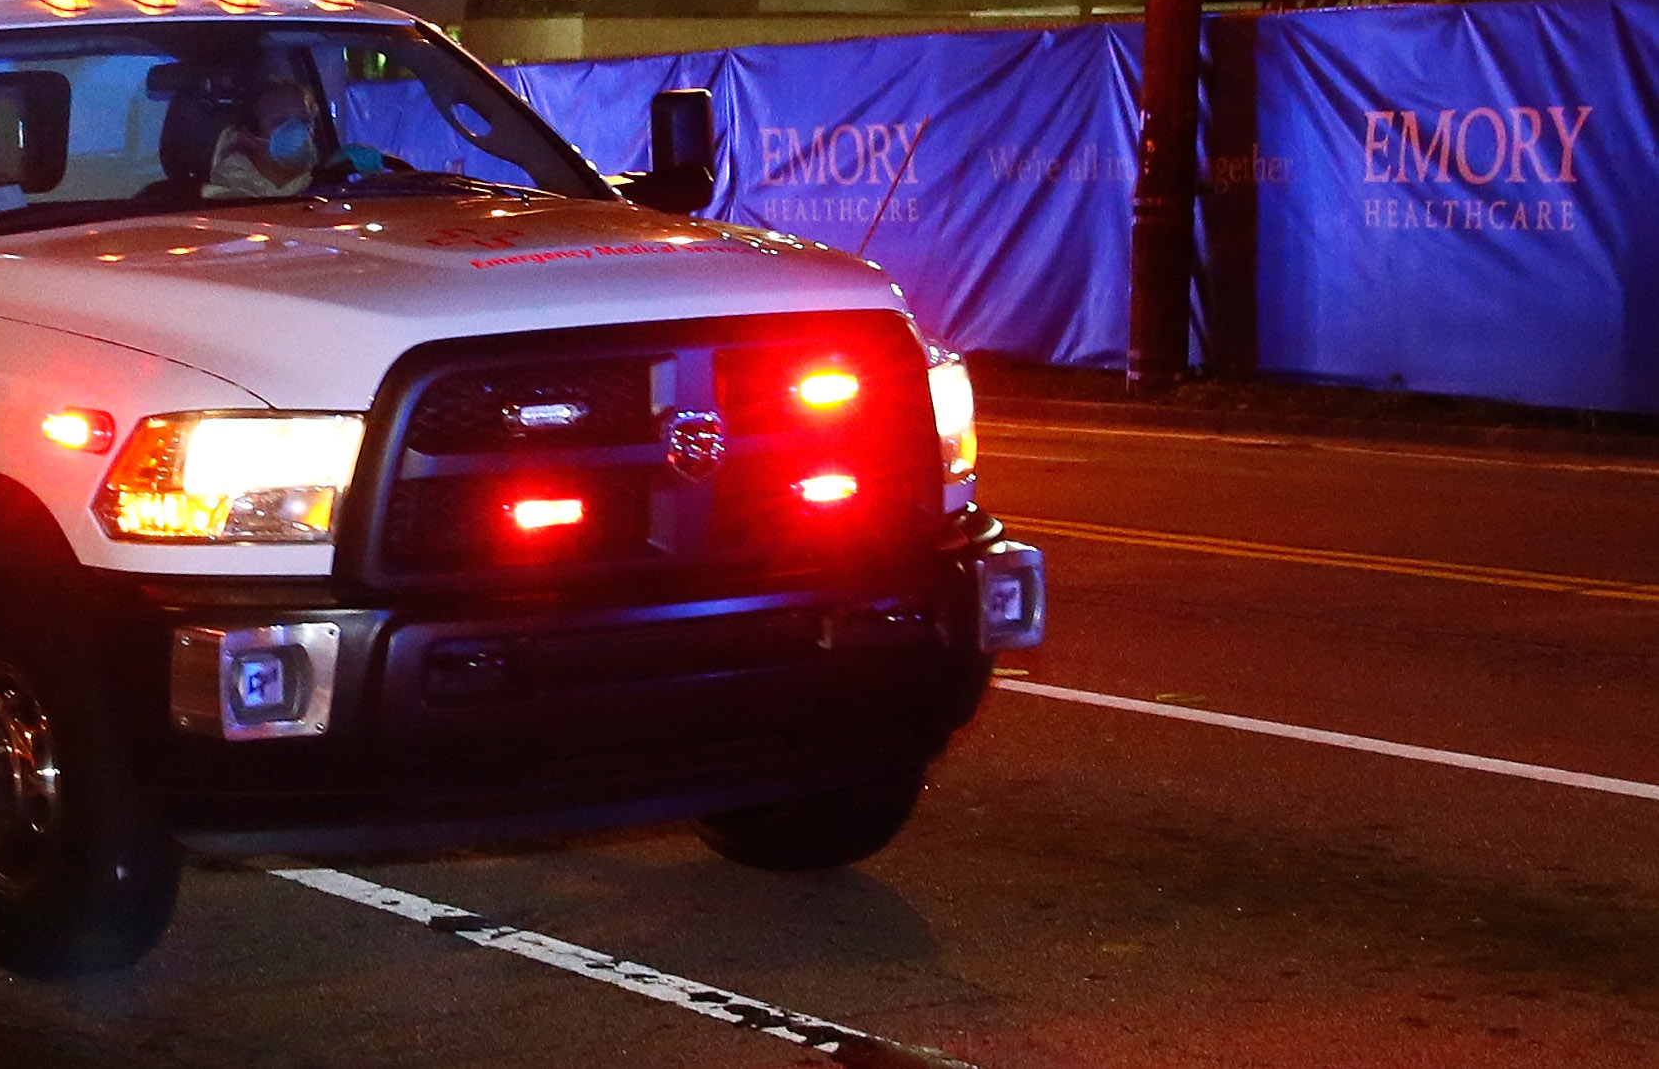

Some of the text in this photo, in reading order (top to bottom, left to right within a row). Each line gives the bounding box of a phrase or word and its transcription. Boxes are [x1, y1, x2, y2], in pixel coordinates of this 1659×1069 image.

[760, 123, 929, 185] EMORY
[1364, 106, 1593, 184] EMORY
[764, 196, 919, 223] HEALTHCARE
[1364, 199, 1577, 231] HEALTHCARE
[470, 248, 593, 270] Emergency
[593, 244, 677, 257] Medical
